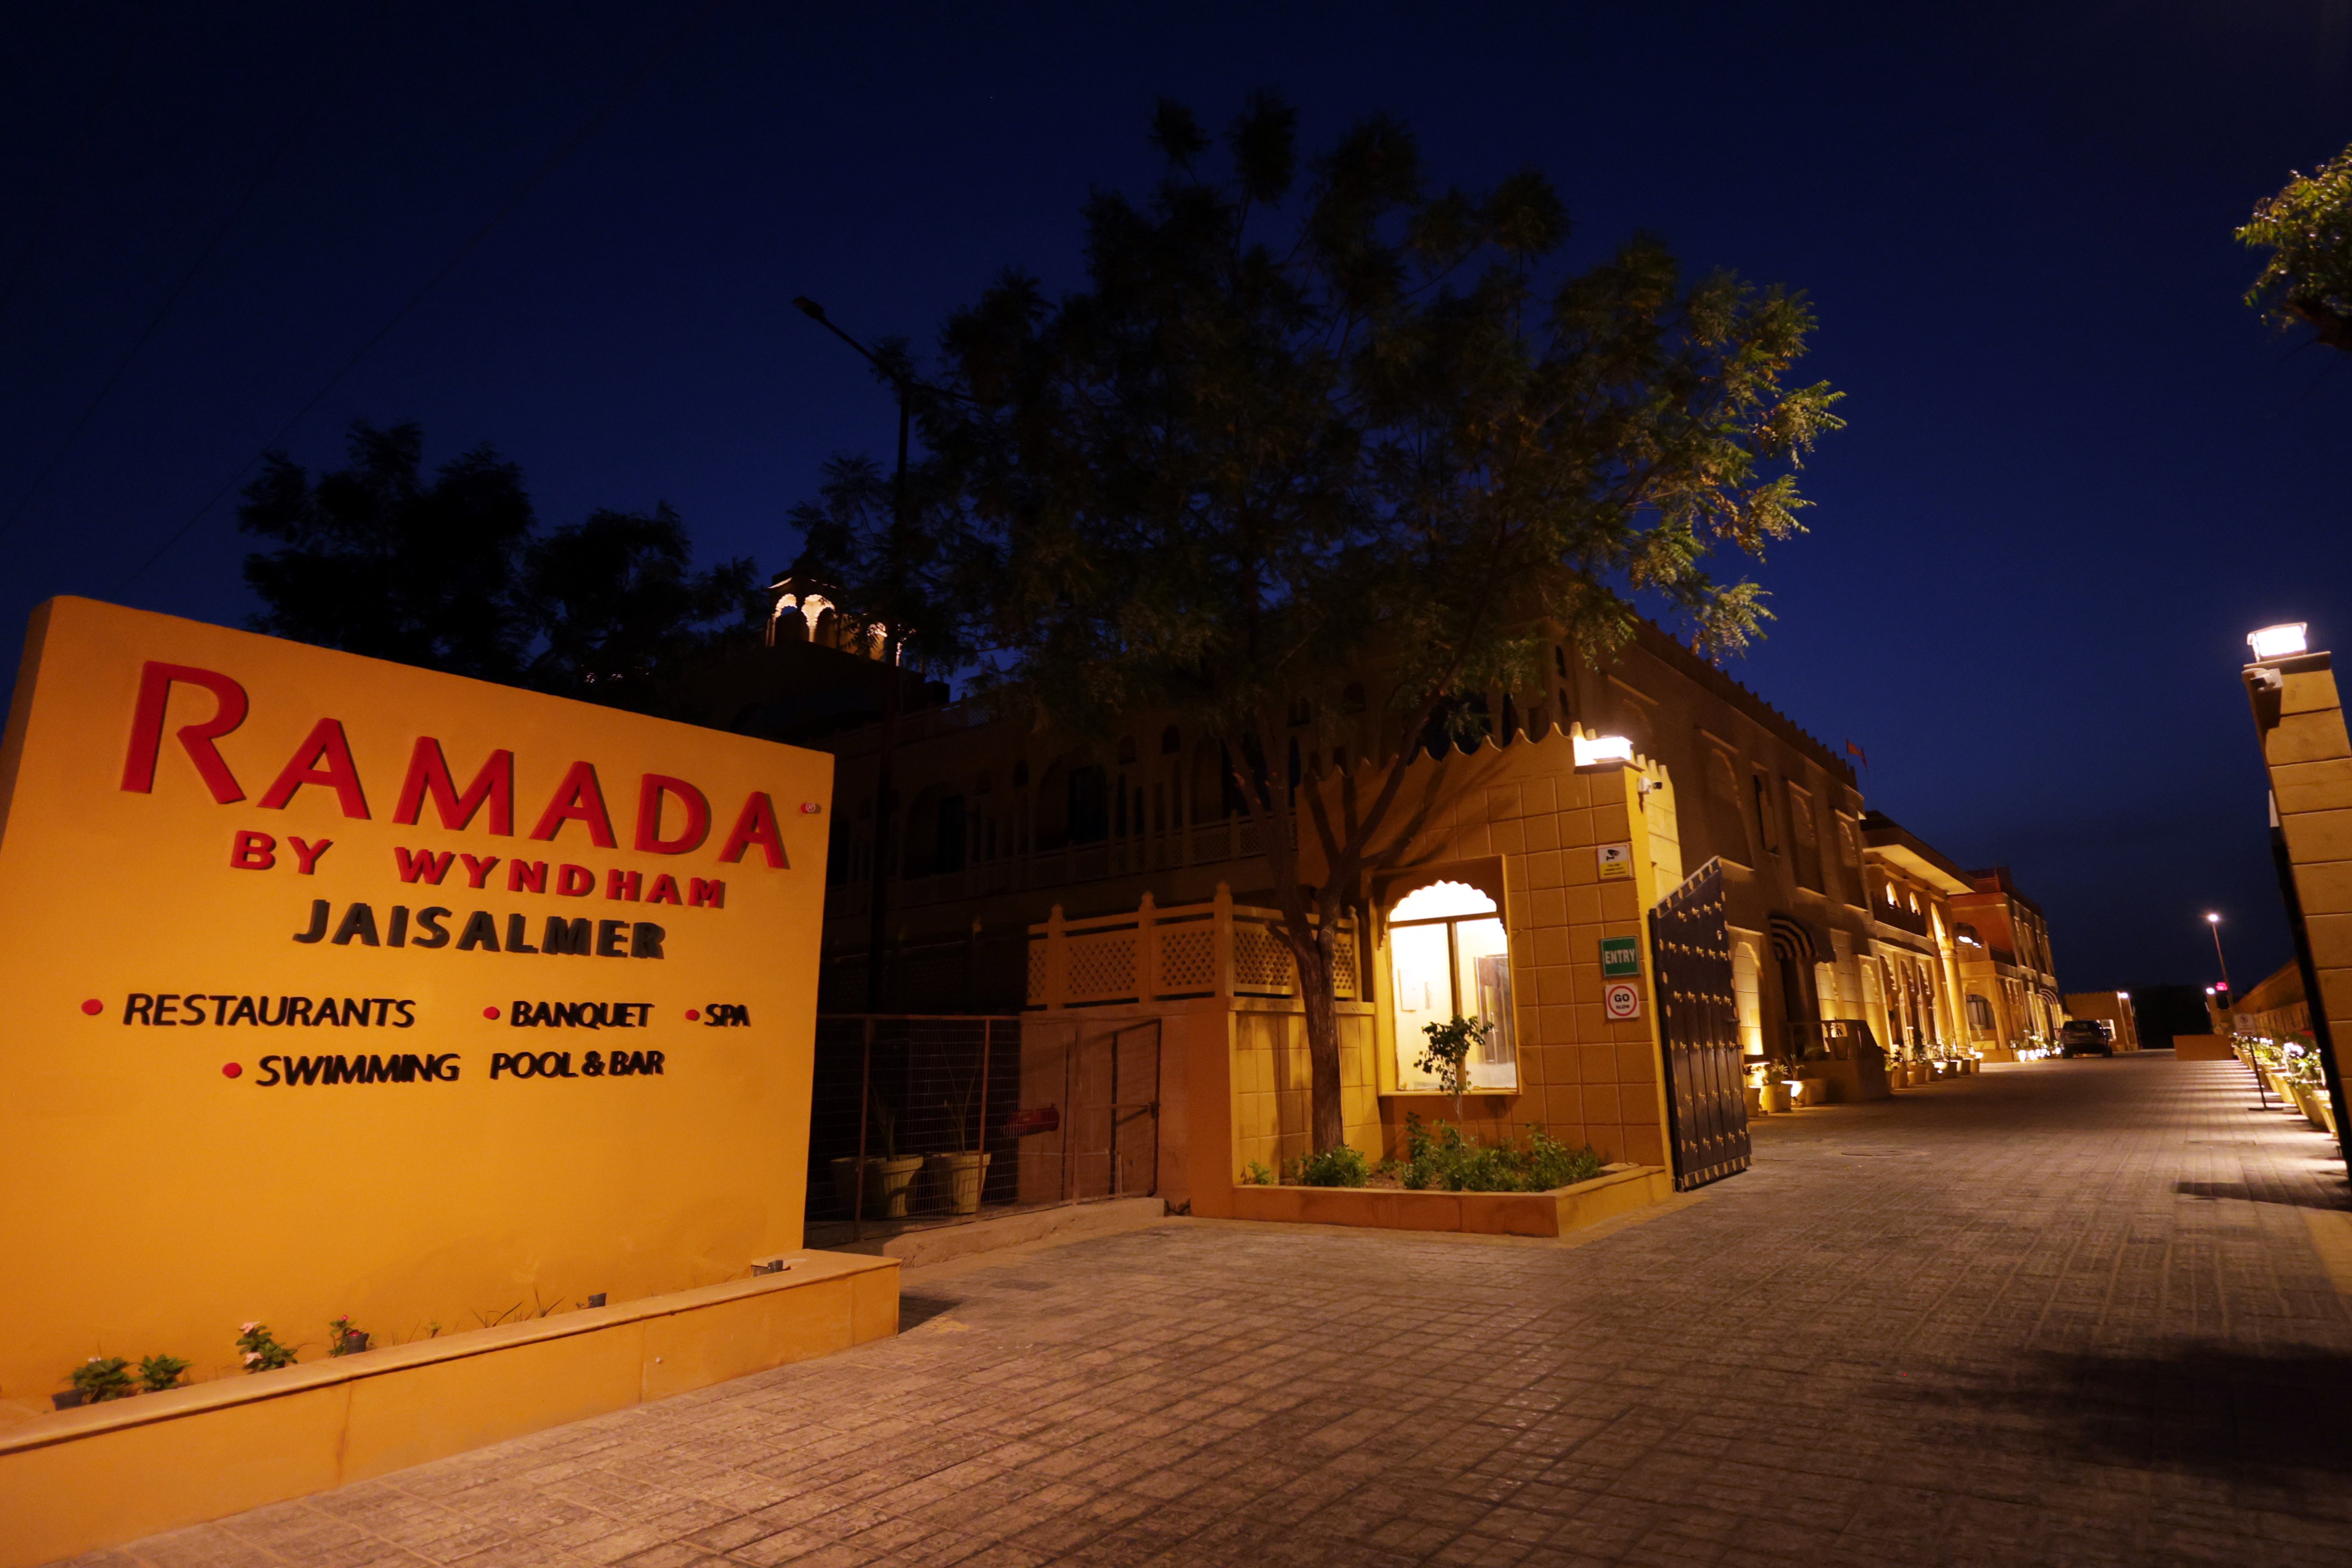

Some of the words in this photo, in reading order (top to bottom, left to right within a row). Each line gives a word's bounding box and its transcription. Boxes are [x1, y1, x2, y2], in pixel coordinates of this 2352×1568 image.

[121, 660, 789, 869] RAMADA
[231, 830, 333, 875] BY
[394, 847, 724, 908] WYNDHAM
[292, 899, 665, 960] JAISALMER
[1605, 949, 1635, 965] ENTRY
[122, 993, 416, 1028] RESTAURANTS
[510, 1001, 655, 1030] BANQUET
[704, 1004, 751, 1027] SPA
[1614, 993, 1630, 1002] GO
[255, 1053, 461, 1086] SWIMMING
[490, 1052, 579, 1080] POOL
